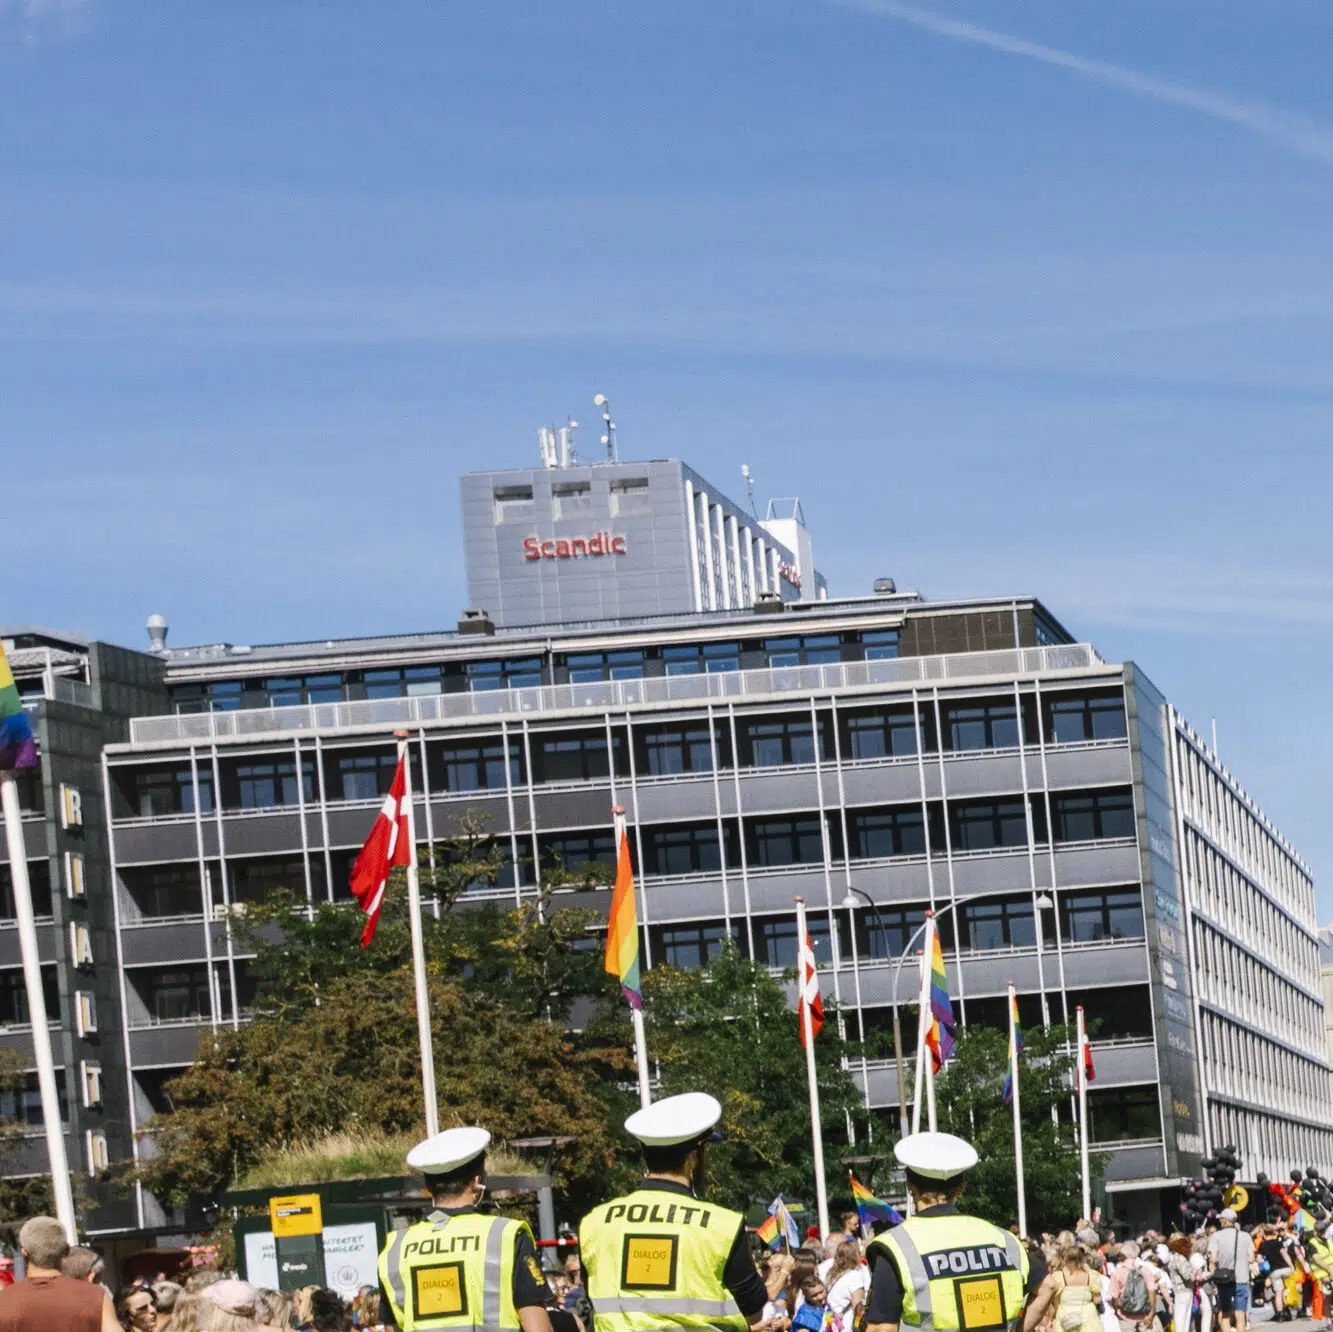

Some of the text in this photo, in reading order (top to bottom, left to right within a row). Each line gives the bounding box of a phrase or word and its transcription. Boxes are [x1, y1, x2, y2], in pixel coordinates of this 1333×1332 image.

[523, 531, 626, 559] Scandic
[60, 782, 109, 1177] RIALTO
[604, 1203, 711, 1229] POLITI
[404, 1235, 480, 1259] POLITI
[633, 1250, 667, 1260] DIALOG
[645, 1264, 652, 1273] 2
[422, 1278, 455, 1290] DIALOG
[966, 1291, 997, 1304] DIALOG
[981, 1306, 987, 1314] 2
